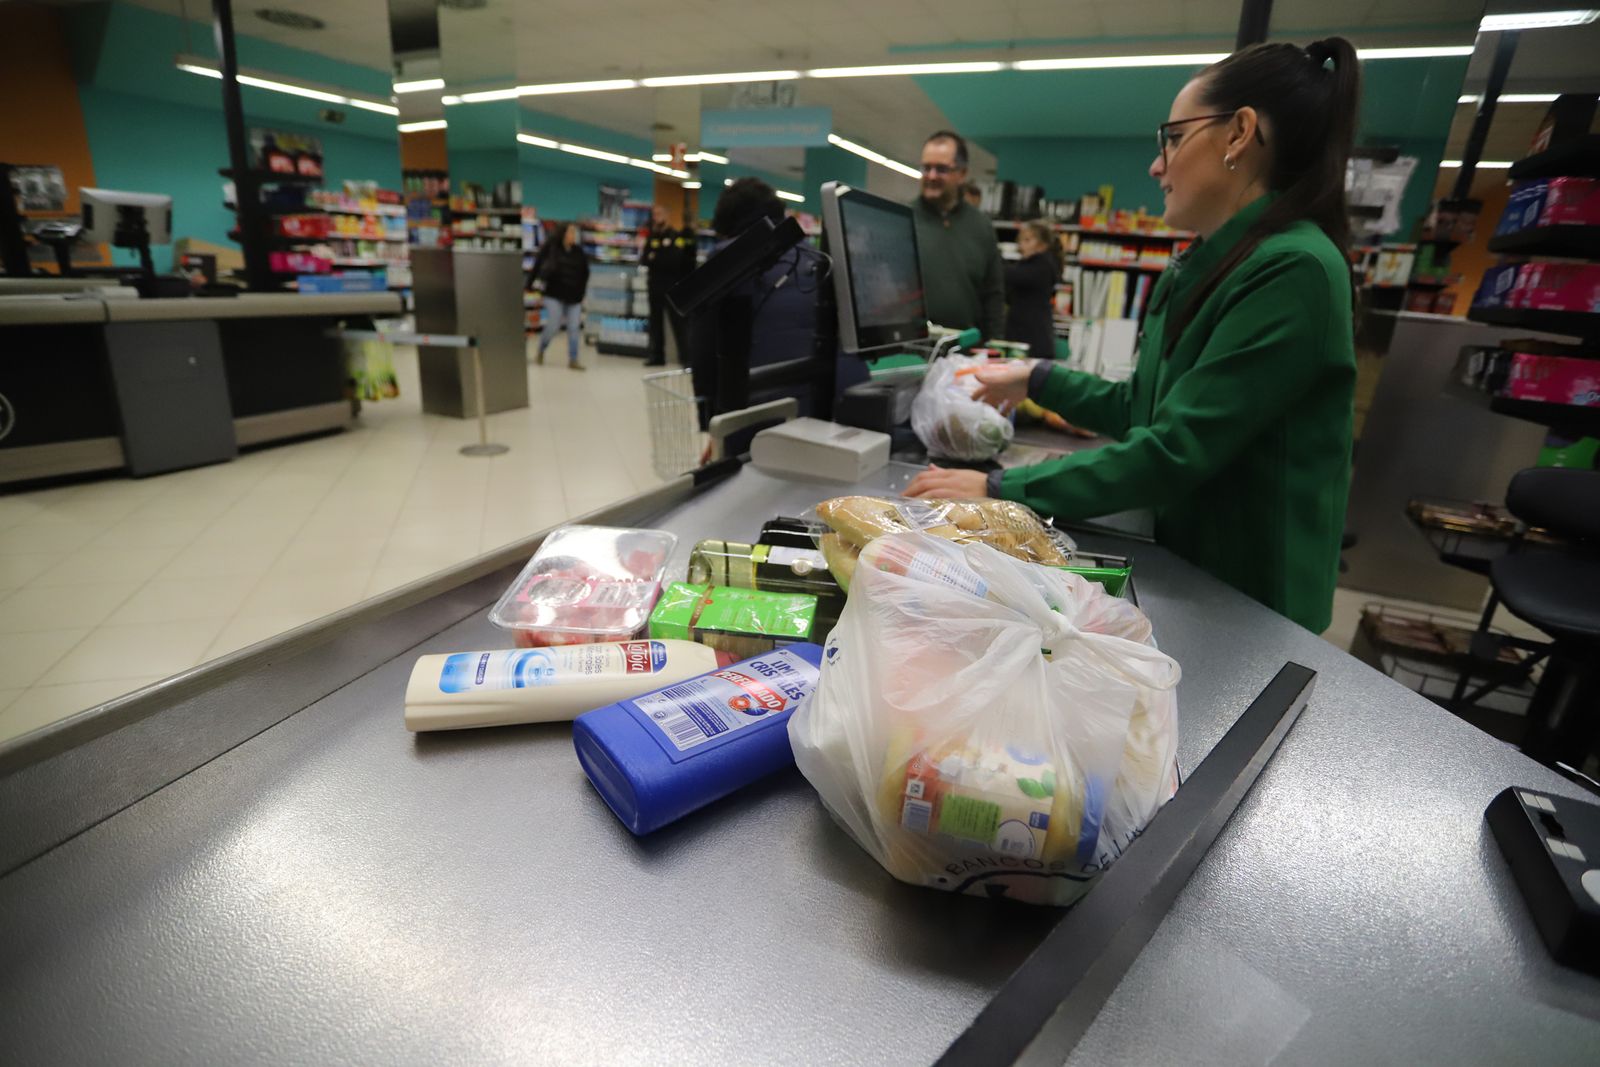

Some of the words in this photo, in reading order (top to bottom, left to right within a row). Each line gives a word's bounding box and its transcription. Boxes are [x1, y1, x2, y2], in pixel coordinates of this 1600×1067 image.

[714, 671, 783, 709] PERFUADO
[750, 661, 806, 701] CRISTLES
[770, 660, 808, 689] LIMPA
[945, 856, 1066, 877] BANCOS
